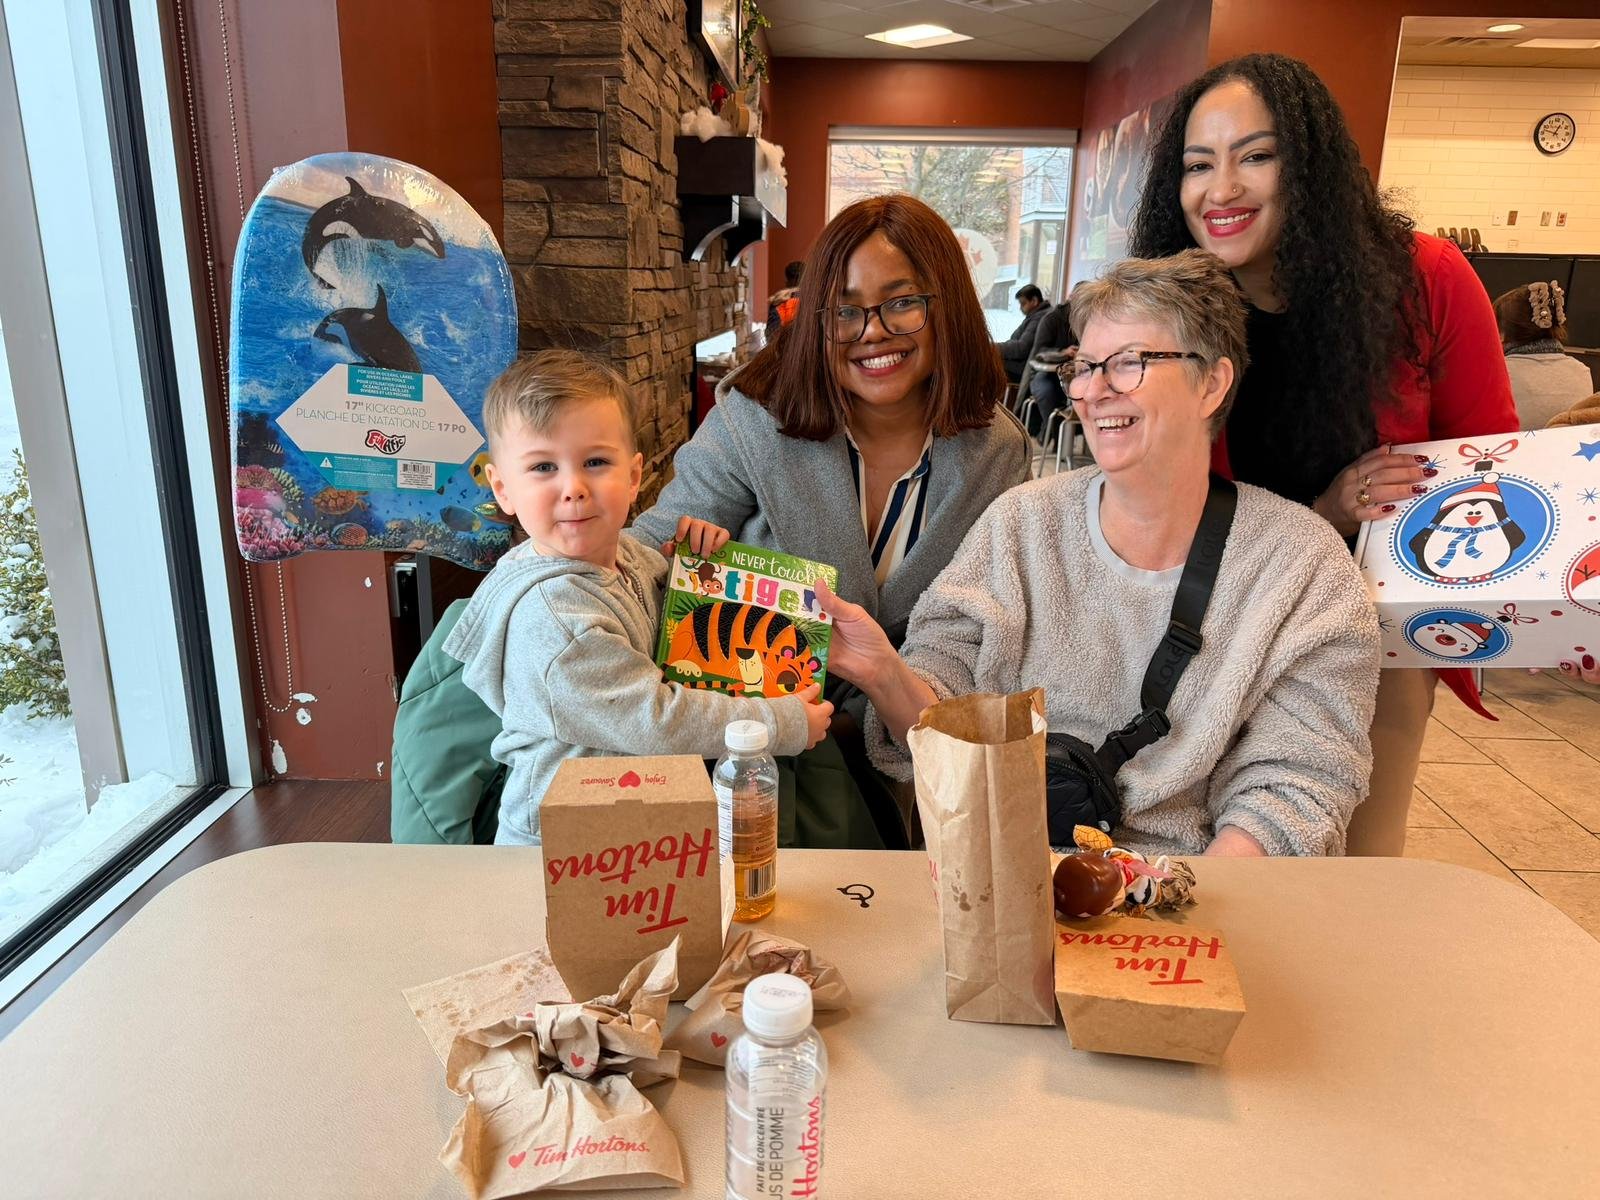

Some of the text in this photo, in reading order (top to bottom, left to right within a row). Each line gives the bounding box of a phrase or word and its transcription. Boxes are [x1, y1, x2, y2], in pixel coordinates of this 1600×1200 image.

[296, 408, 466, 433] PLANCHE DE NATATION DE 17 PO
[366, 403, 426, 417] KICKBOARD
[731, 550, 766, 570] NEVER
[767, 557, 817, 584] touch
[724, 570, 826, 620] tiger
[644, 774, 666, 785] Enjoy
[547, 828, 715, 885] Hortons
[605, 883, 688, 935] Tim
[1060, 932, 1224, 959] Hortons
[1114, 957, 1203, 985] Tim
[769, 1107, 784, 1160] POMME
[533, 1143, 568, 1166] Tim
[756, 1161, 765, 1172] DE
[756, 1175, 765, 1193] FAIT
[769, 1161, 783, 1181] DE
